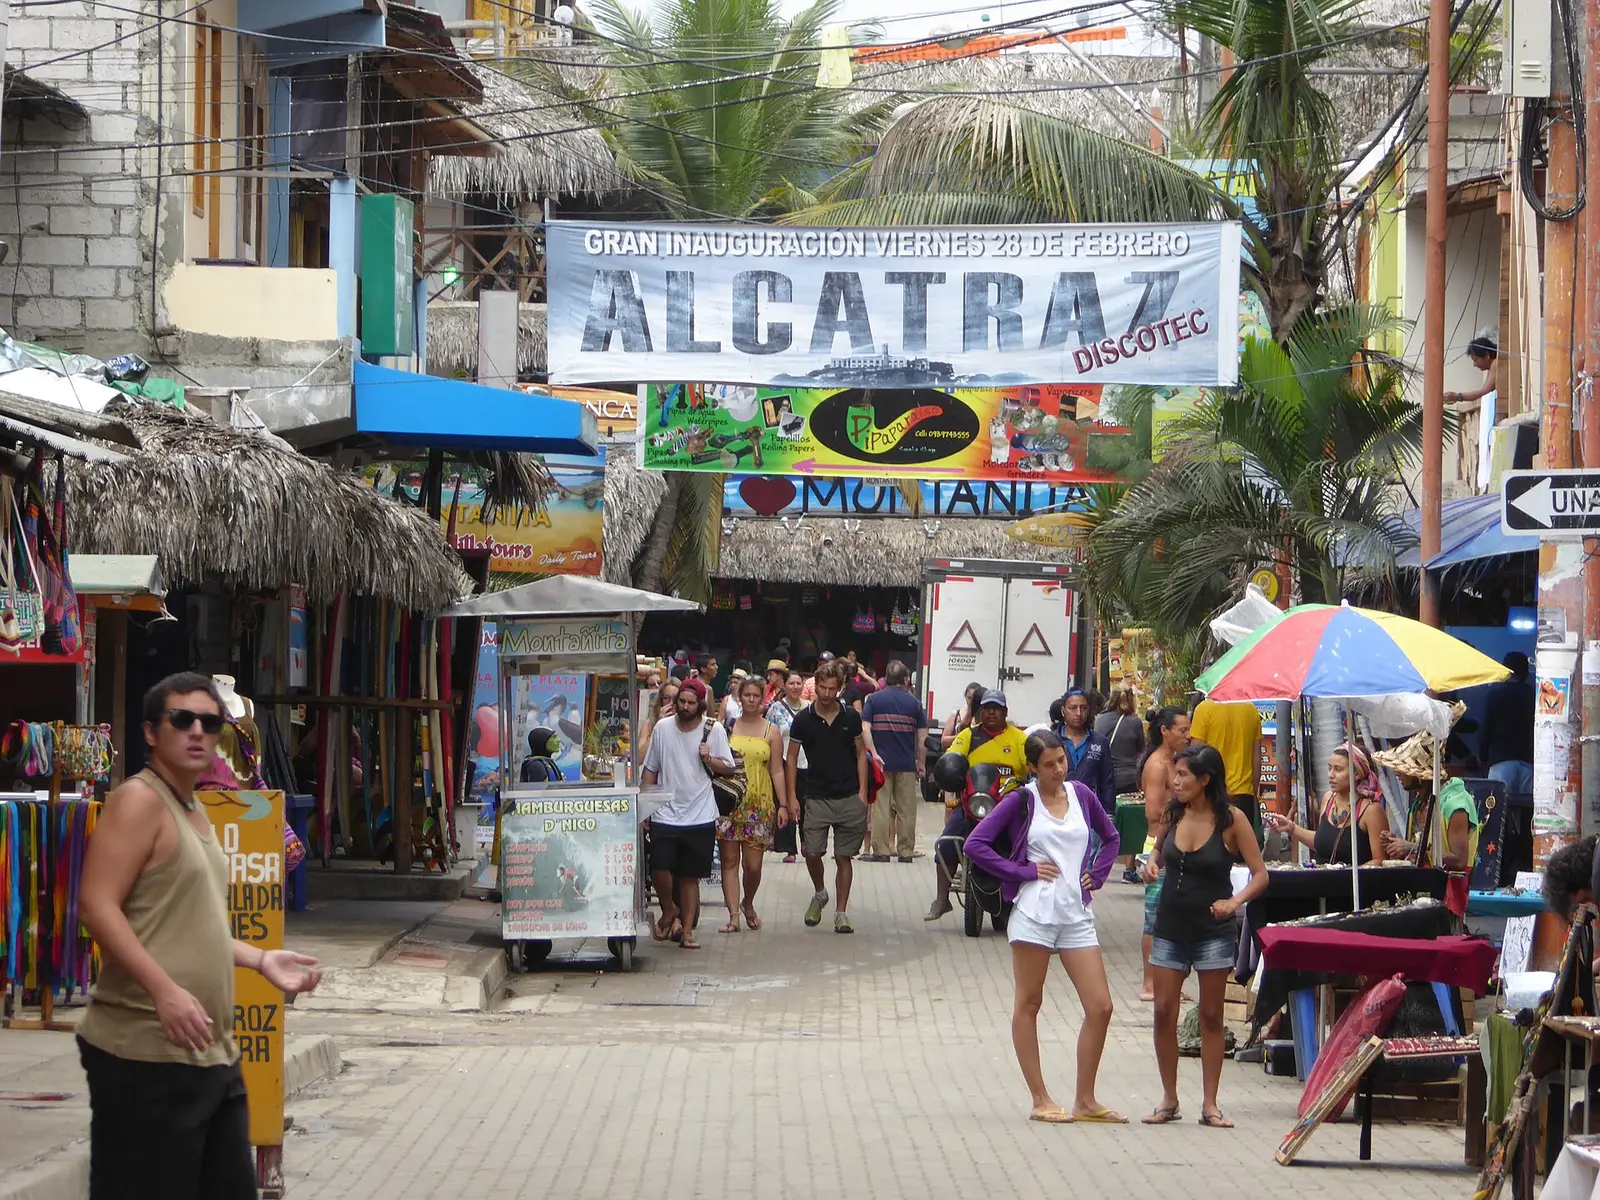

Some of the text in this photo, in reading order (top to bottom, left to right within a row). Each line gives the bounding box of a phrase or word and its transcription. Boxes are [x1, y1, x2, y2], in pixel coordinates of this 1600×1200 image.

[584, 228, 1191, 258] GRAN INAUGURACIÓN VIERNES 28 DE FEBRERO
[580, 268, 1180, 355] ALCATRAZ
[1072, 307, 1209, 375] DISCOTEC
[1046, 387, 1094, 398] Vaporizers
[586, 400, 636, 418] NCA
[687, 417, 728, 428] Waterpipes
[851, 405, 939, 451] Pipaparaiso
[771, 434, 811, 445] Papelillos
[762, 443, 816, 453] Rolling Papers
[1007, 470, 1046, 479] Grinders
[1032, 535, 1053, 543] HOSTEL
[539, 550, 598, 566] Daily Tours
[500, 625, 628, 654] Montañita
[540, 676, 578, 685] PLATA
[997, 767, 1012, 776] NER
[512, 799, 630, 816] HAMBURGUESAS
[232, 1035, 270, 1063] RA
